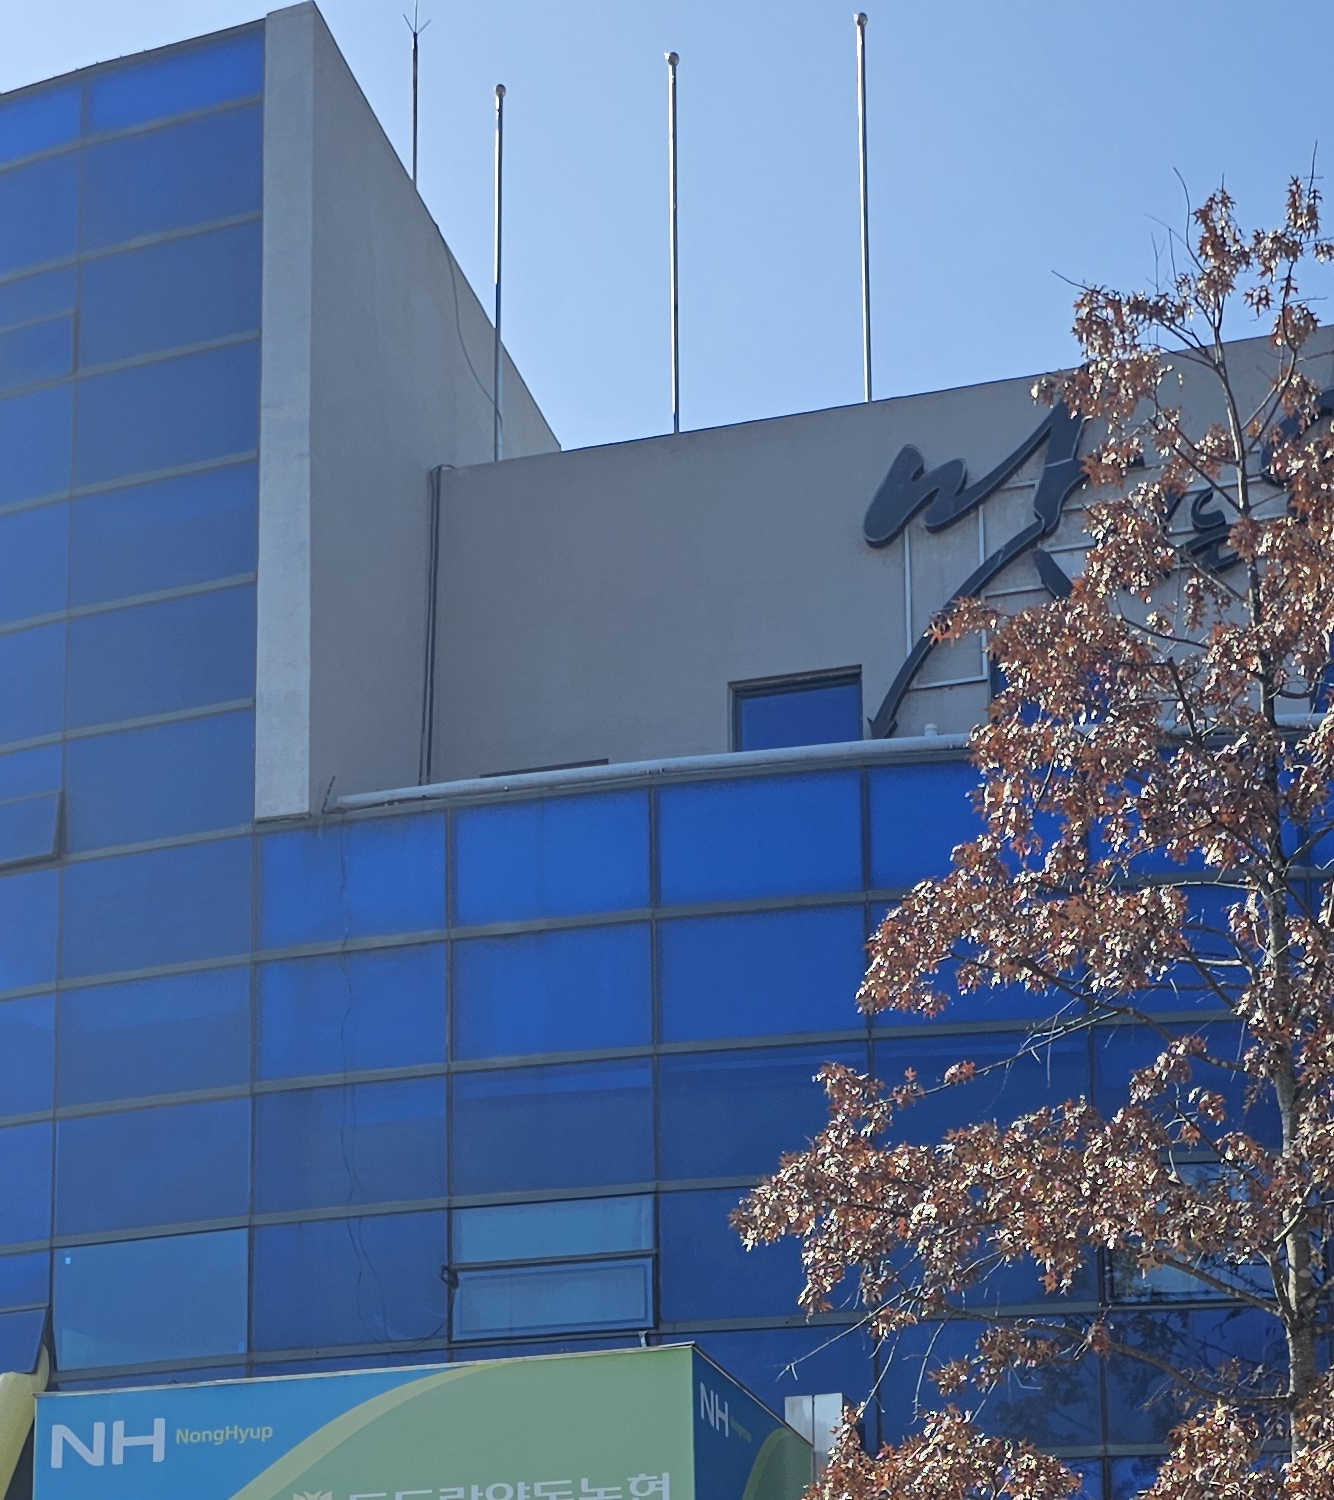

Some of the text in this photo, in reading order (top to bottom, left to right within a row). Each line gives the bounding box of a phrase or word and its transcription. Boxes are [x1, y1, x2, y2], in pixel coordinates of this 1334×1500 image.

[700, 1381, 729, 1438] NH
[50, 1417, 274, 1470] NH NongHyup
